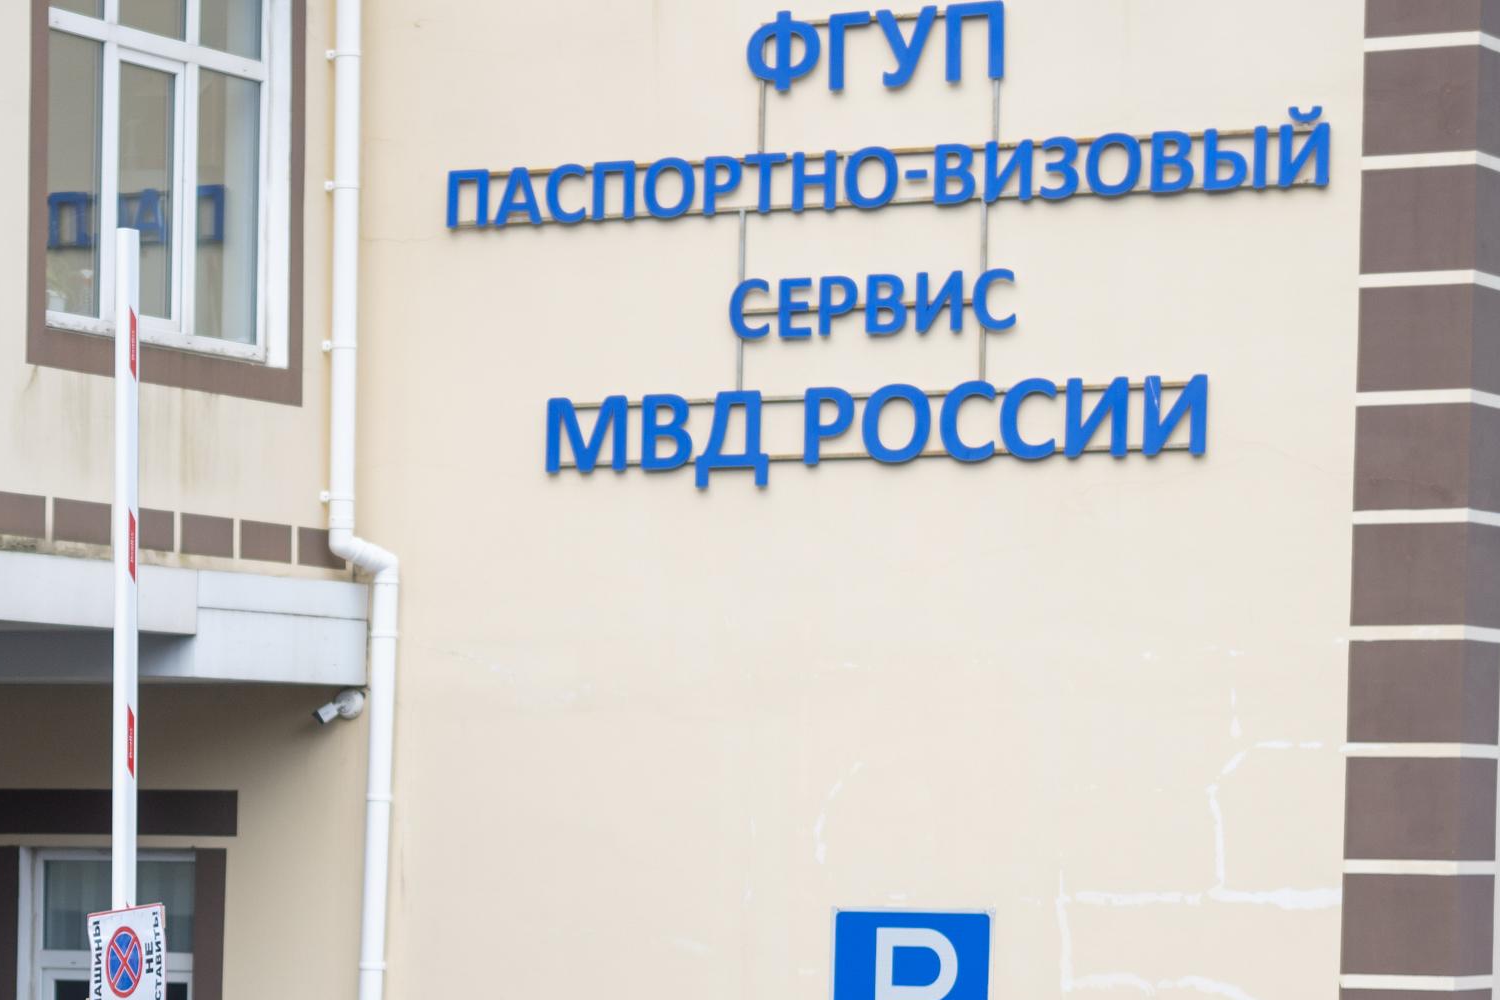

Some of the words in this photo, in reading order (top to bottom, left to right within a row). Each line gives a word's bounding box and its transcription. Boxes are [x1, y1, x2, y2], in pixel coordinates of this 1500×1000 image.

[747, 1, 1005, 91] ФГУП
[447, 107, 1330, 228] ПАСПОРТНО-ВИЗОВЫЙ
[729, 269, 1016, 338] СЕРВИС
[547, 391, 770, 488] МВД
[804, 375, 1208, 465] РОССИИ
[145, 941, 153, 974] НЕ
[153, 912, 162, 1000] СТАВИТЬ!
